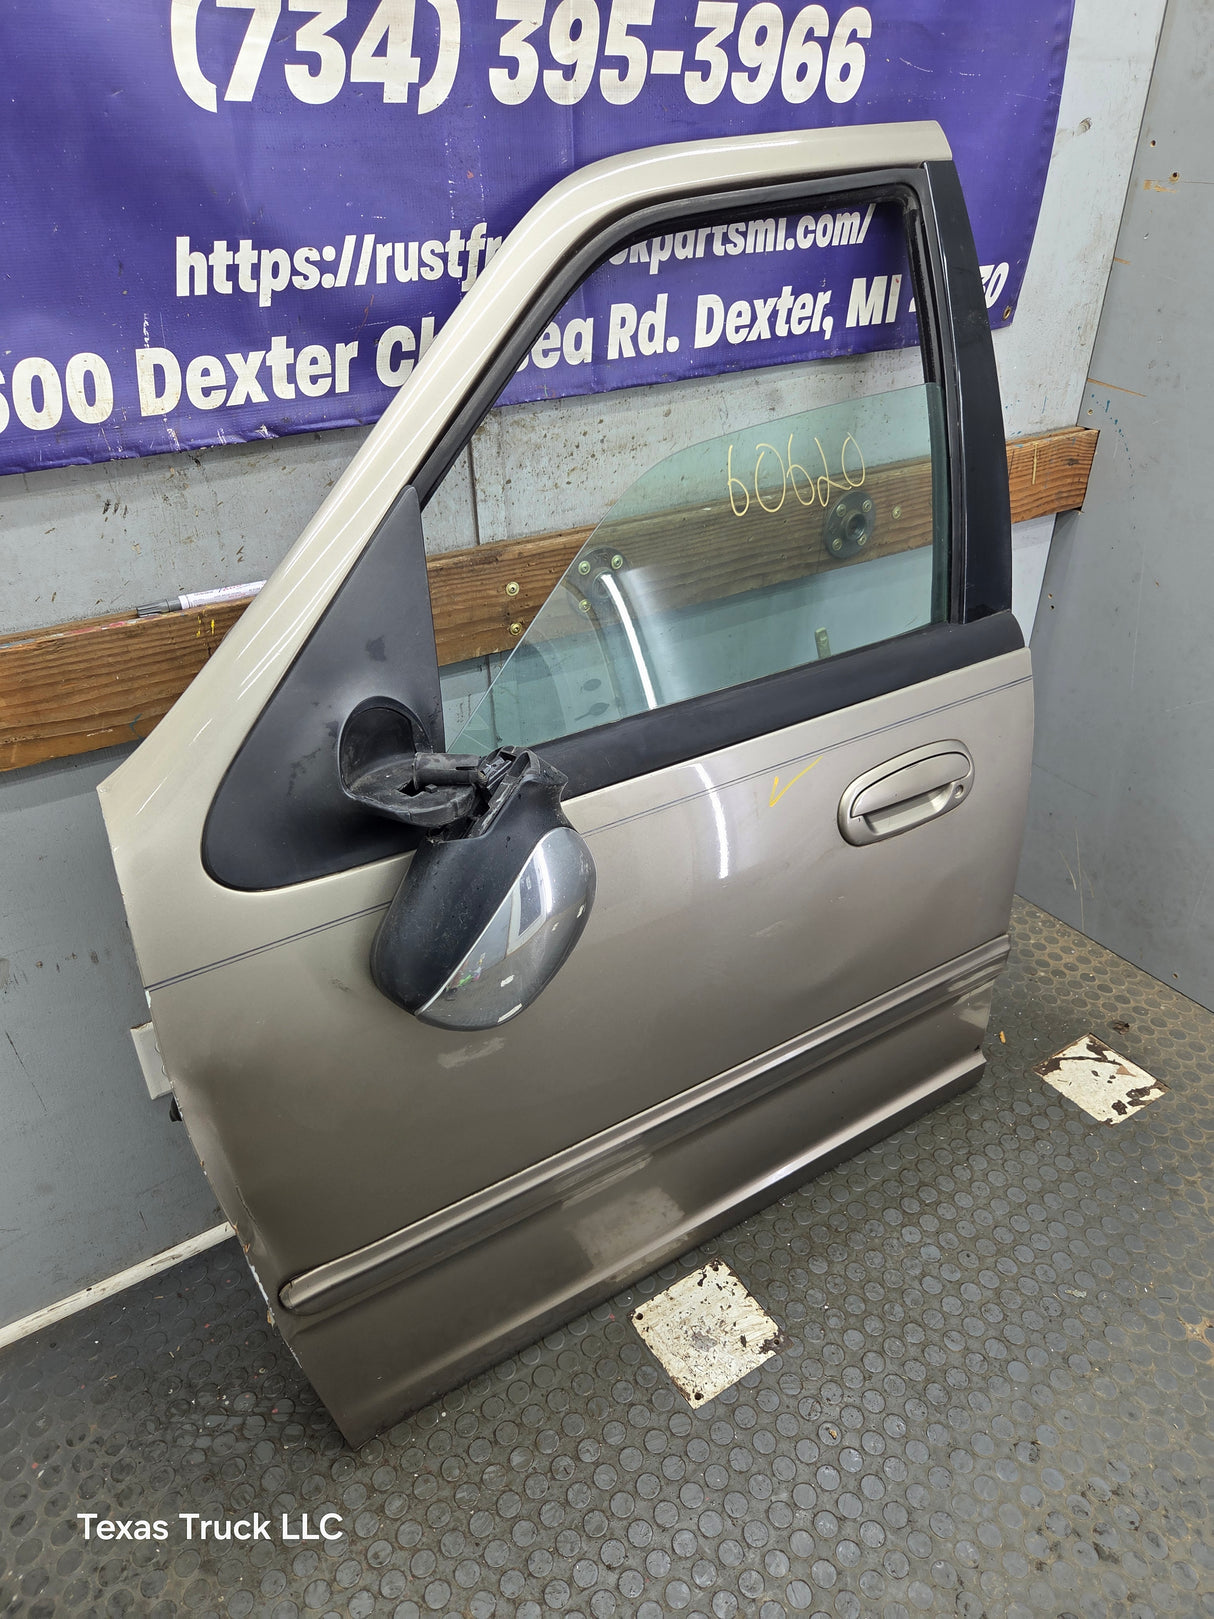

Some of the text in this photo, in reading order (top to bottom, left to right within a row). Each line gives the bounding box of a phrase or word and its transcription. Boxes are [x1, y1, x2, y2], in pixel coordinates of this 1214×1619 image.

[170, 0, 873, 115] (734) 395-3966
[0, 353, 114, 434] 00
[136, 335, 359, 417] Dexter
[375, 316, 594, 388] Chea
[607, 293, 680, 360] Rd.
[694, 285, 834, 349] Dexter,
[845, 274, 903, 328] MI
